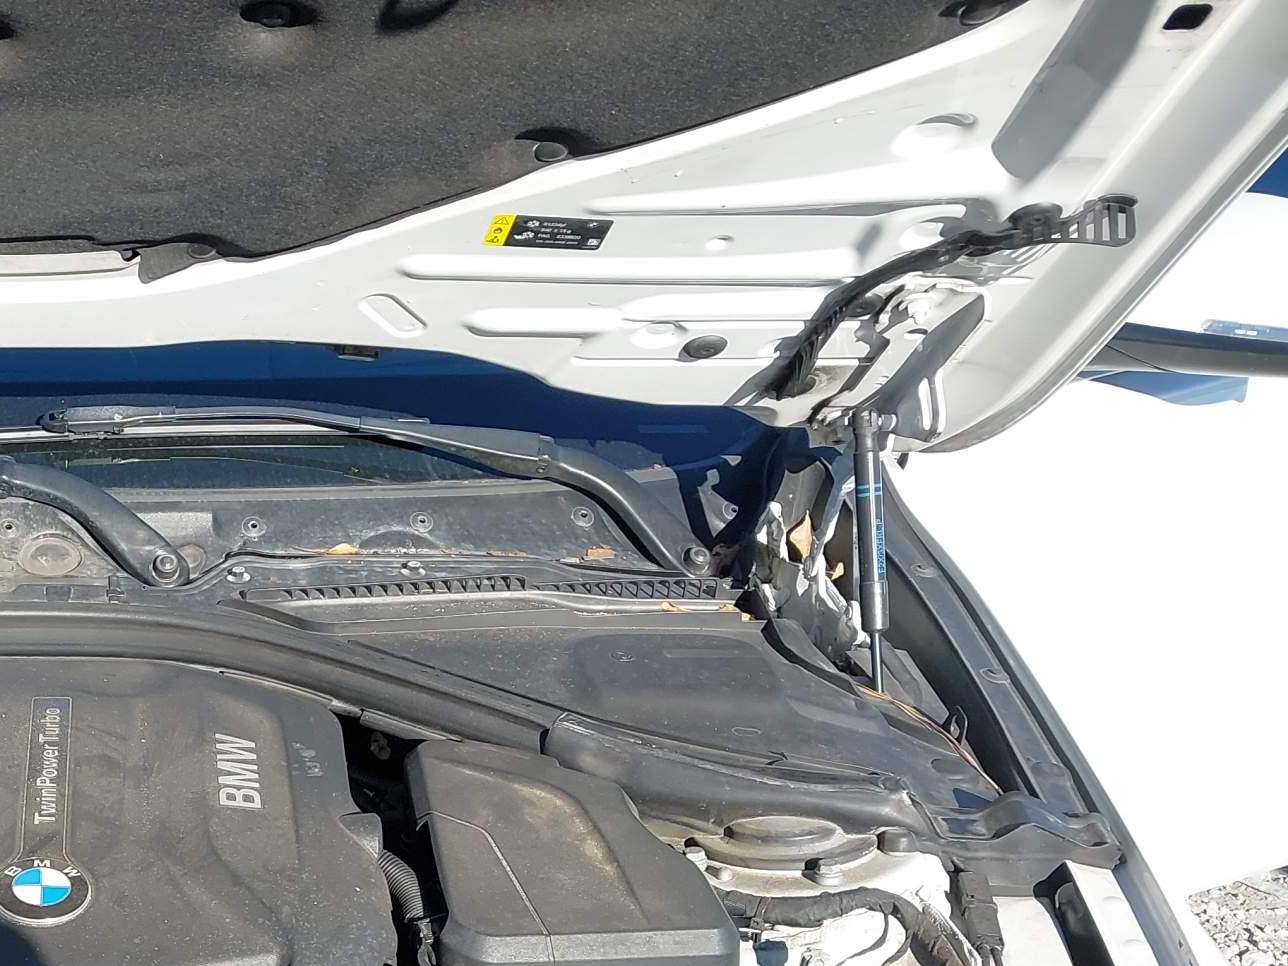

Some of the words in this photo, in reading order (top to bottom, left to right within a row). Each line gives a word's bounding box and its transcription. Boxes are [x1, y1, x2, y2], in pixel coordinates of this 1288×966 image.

[39, 707, 61, 743] Turbo
[34, 744, 59, 824] TwinPower
[215, 733, 262, 809] BMW
[4, 859, 81, 878] BMW
